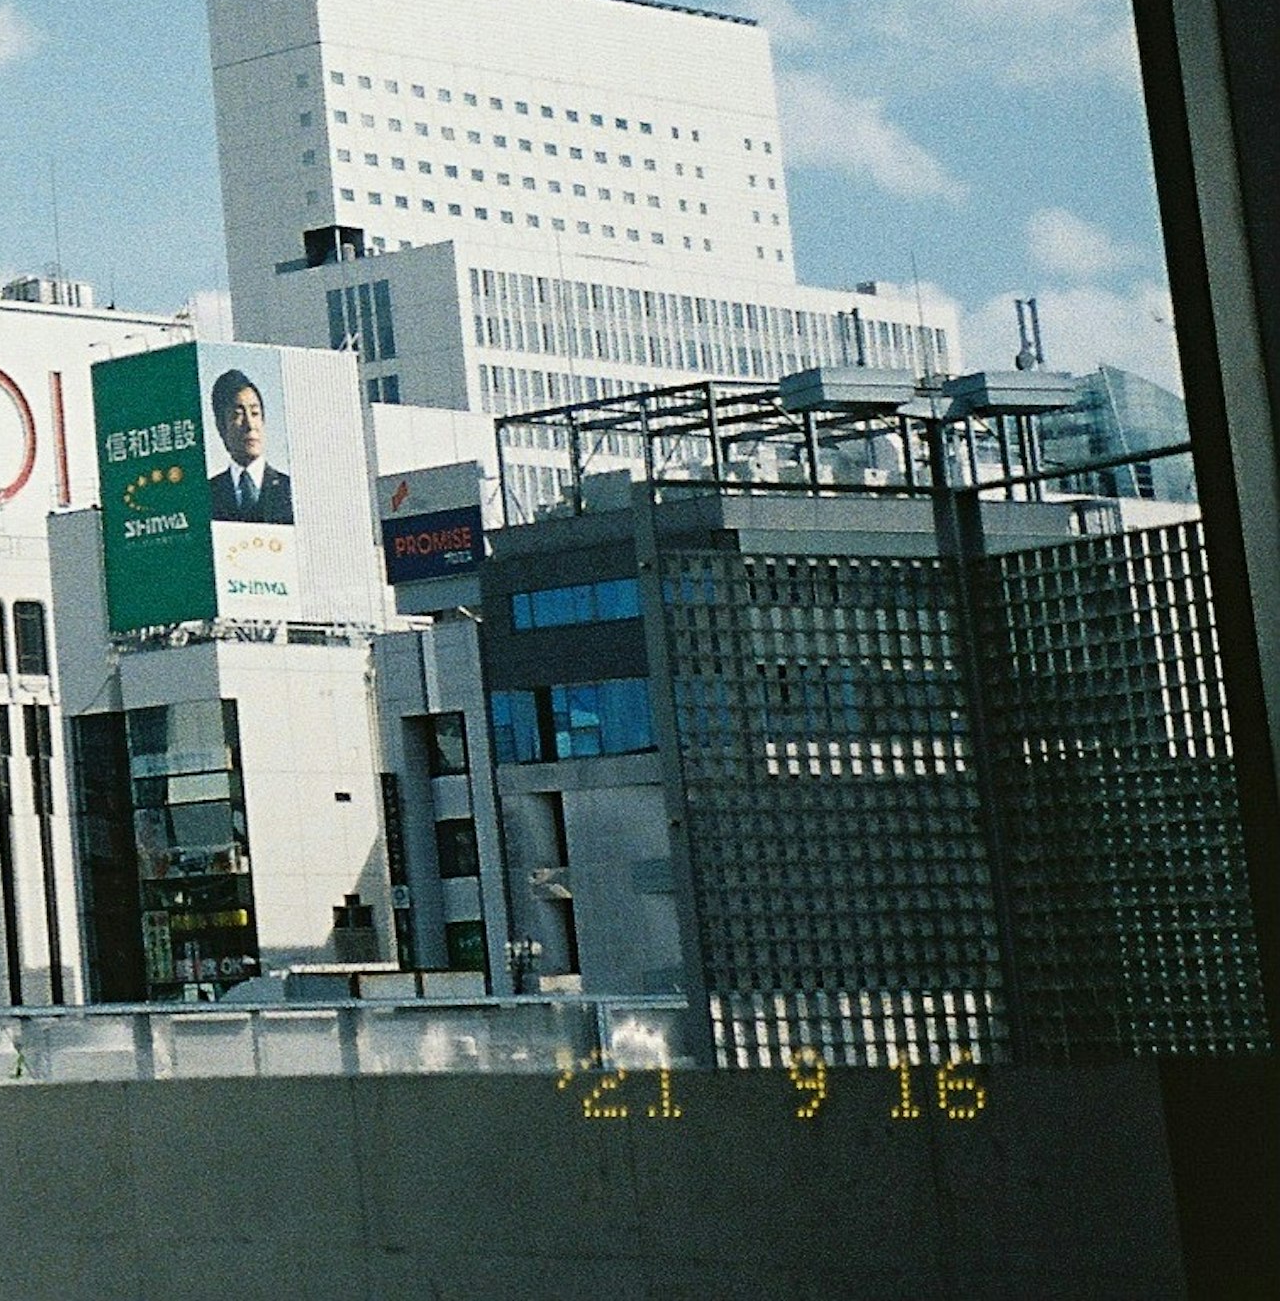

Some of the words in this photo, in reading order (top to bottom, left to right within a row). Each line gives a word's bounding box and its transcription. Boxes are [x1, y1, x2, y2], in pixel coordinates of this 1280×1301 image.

[106, 419, 197, 463] 信和建設
[394, 526, 472, 558] PROMISE
